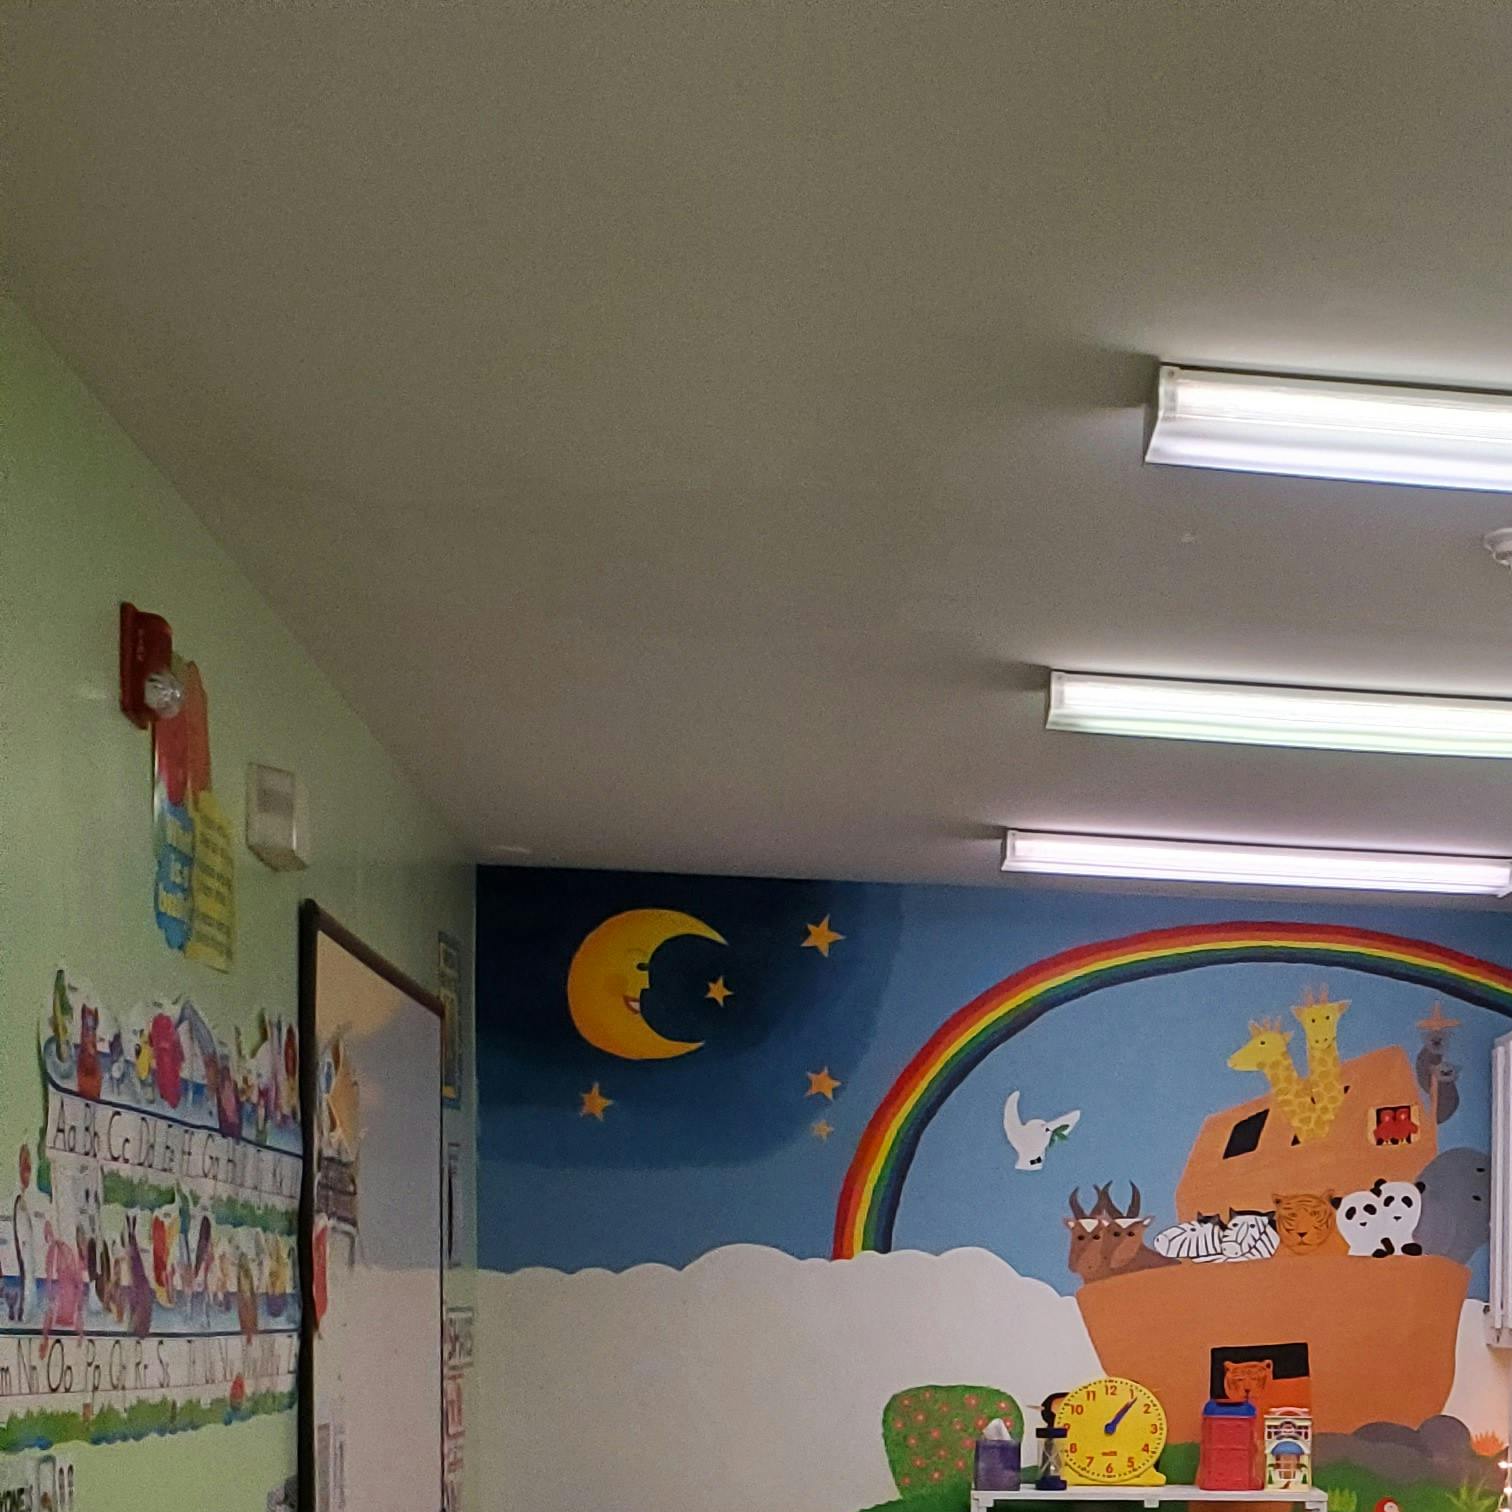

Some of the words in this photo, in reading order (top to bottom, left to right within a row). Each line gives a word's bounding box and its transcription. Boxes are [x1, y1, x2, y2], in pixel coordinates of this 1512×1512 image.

[53, 1097, 76, 1152] Aa
[83, 1102, 100, 1158] Bb
[109, 1110, 130, 1163] Cc
[47, 1338, 74, 1392] Oo
[1104, 1385, 1117, 1396] 12
[1130, 1389, 1134, 1399] 1
[1086, 1391, 1096, 1401] 11
[1070, 1404, 1084, 1415] 10
[1143, 1404, 1151, 1414] 2
[1151, 1424, 1158, 1434] 3
[1070, 1443, 1077, 1453] 8
[1142, 1444, 1149, 1454] 4
[1086, 1457, 1094, 1467] 7
[1127, 1457, 1135, 1467] 5
[1106, 1463, 1113, 1473] 6
